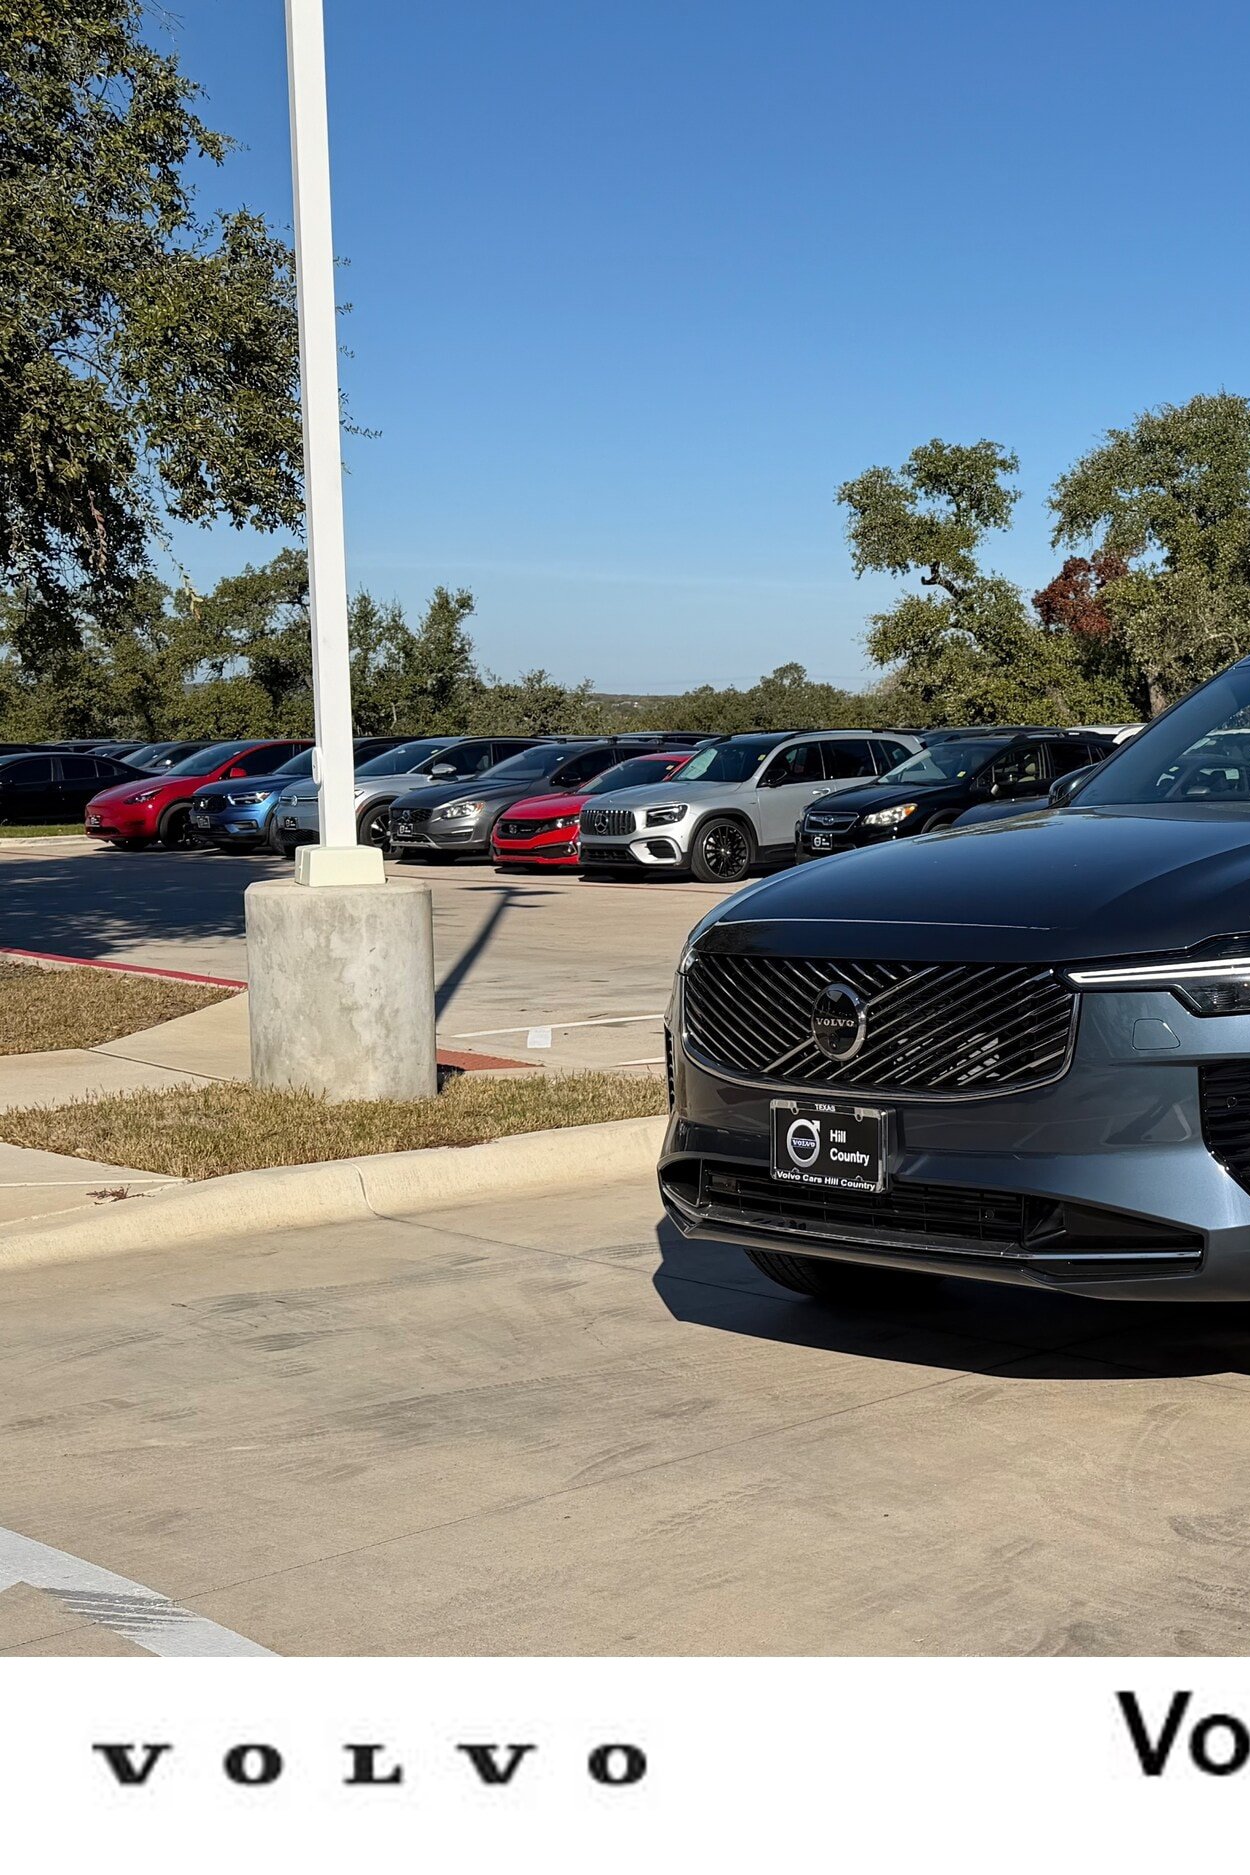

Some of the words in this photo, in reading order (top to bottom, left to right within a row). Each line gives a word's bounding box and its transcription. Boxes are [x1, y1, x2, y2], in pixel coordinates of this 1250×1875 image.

[815, 1017, 855, 1028] VOLVO
[814, 1103, 836, 1112] TEXAS
[829, 1129, 847, 1143] Hill
[792, 1139, 816, 1148] VOLVO
[829, 1147, 870, 1167] Country
[776, 1170, 801, 1181] Volvo
[802, 1174, 822, 1184] Cars
[824, 1176, 839, 1186] Hill
[840, 1179, 876, 1192] Country
